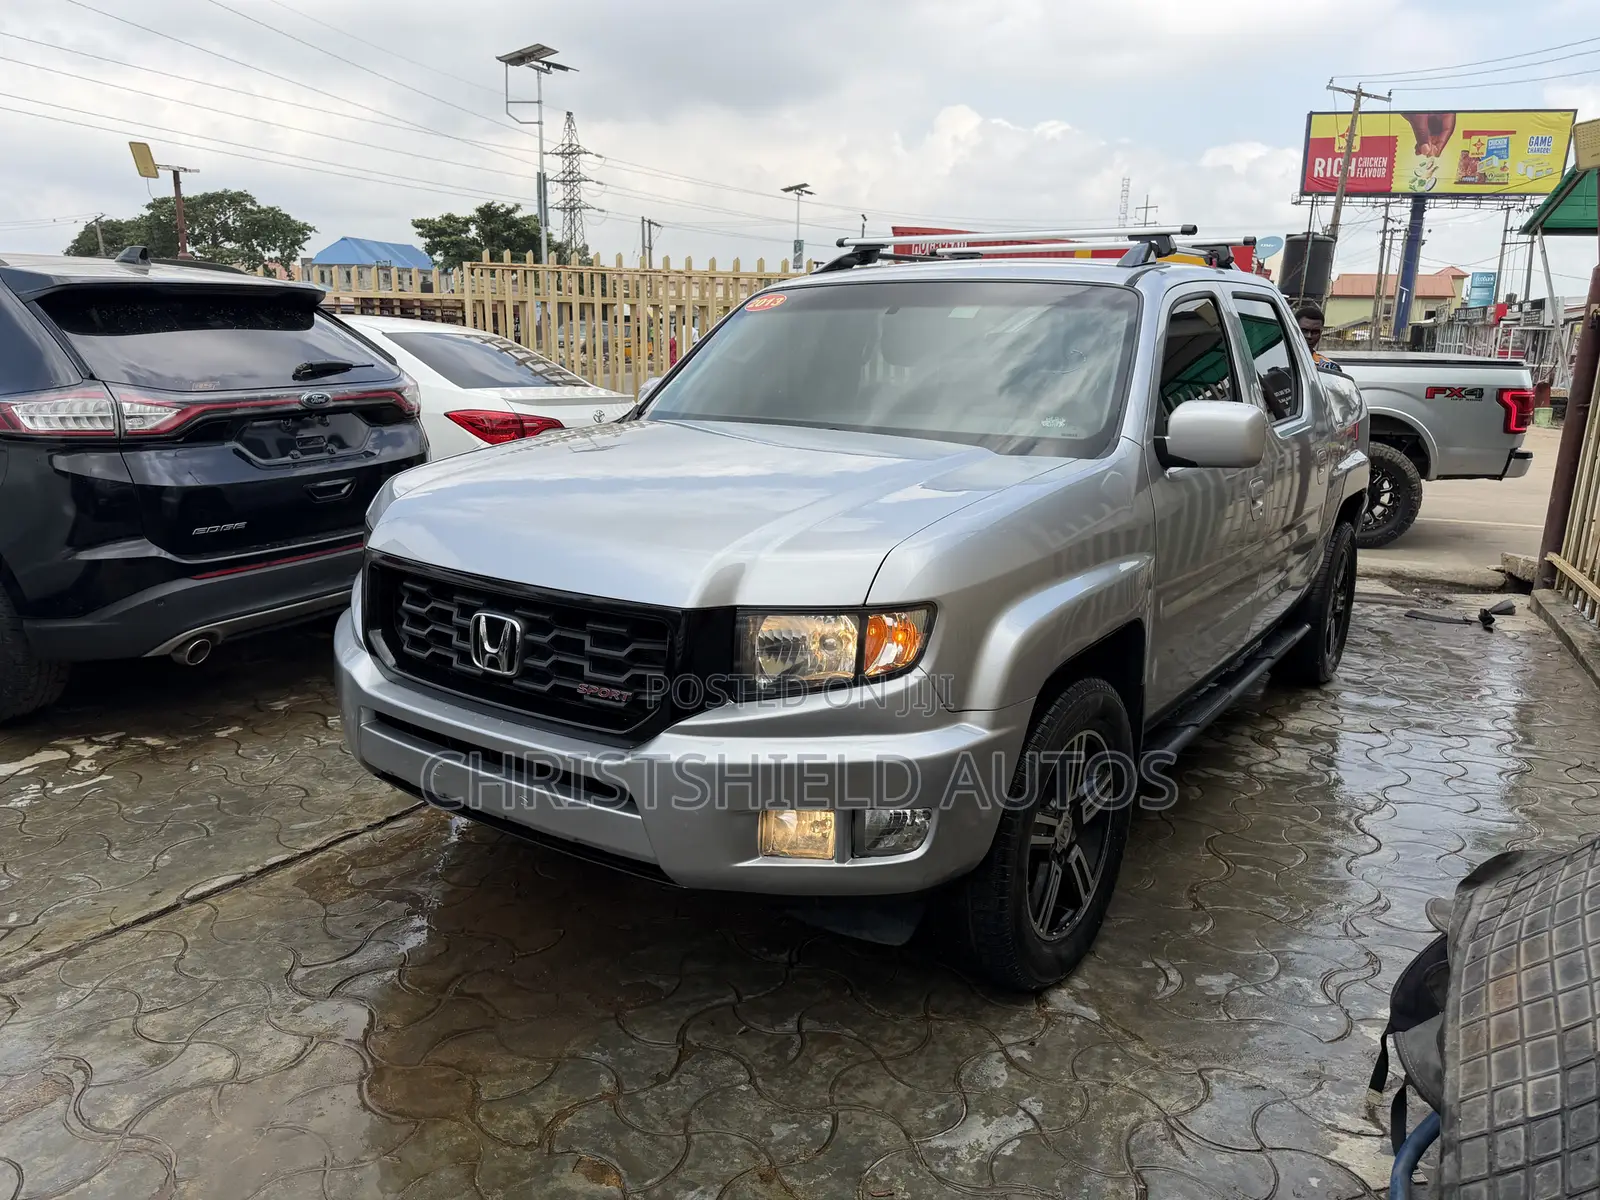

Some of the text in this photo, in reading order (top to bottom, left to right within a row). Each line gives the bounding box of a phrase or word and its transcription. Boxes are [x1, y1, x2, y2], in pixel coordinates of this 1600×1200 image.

[1313, 157, 1357, 178] RICH
[1358, 157, 1388, 168] CHICKEN
[1356, 168, 1387, 178] FLAVOUR
[746, 297, 785, 308] 2013
[1425, 386, 1484, 399] FX4
[192, 521, 248, 536] EDGE
[576, 683, 633, 702] SPORT
